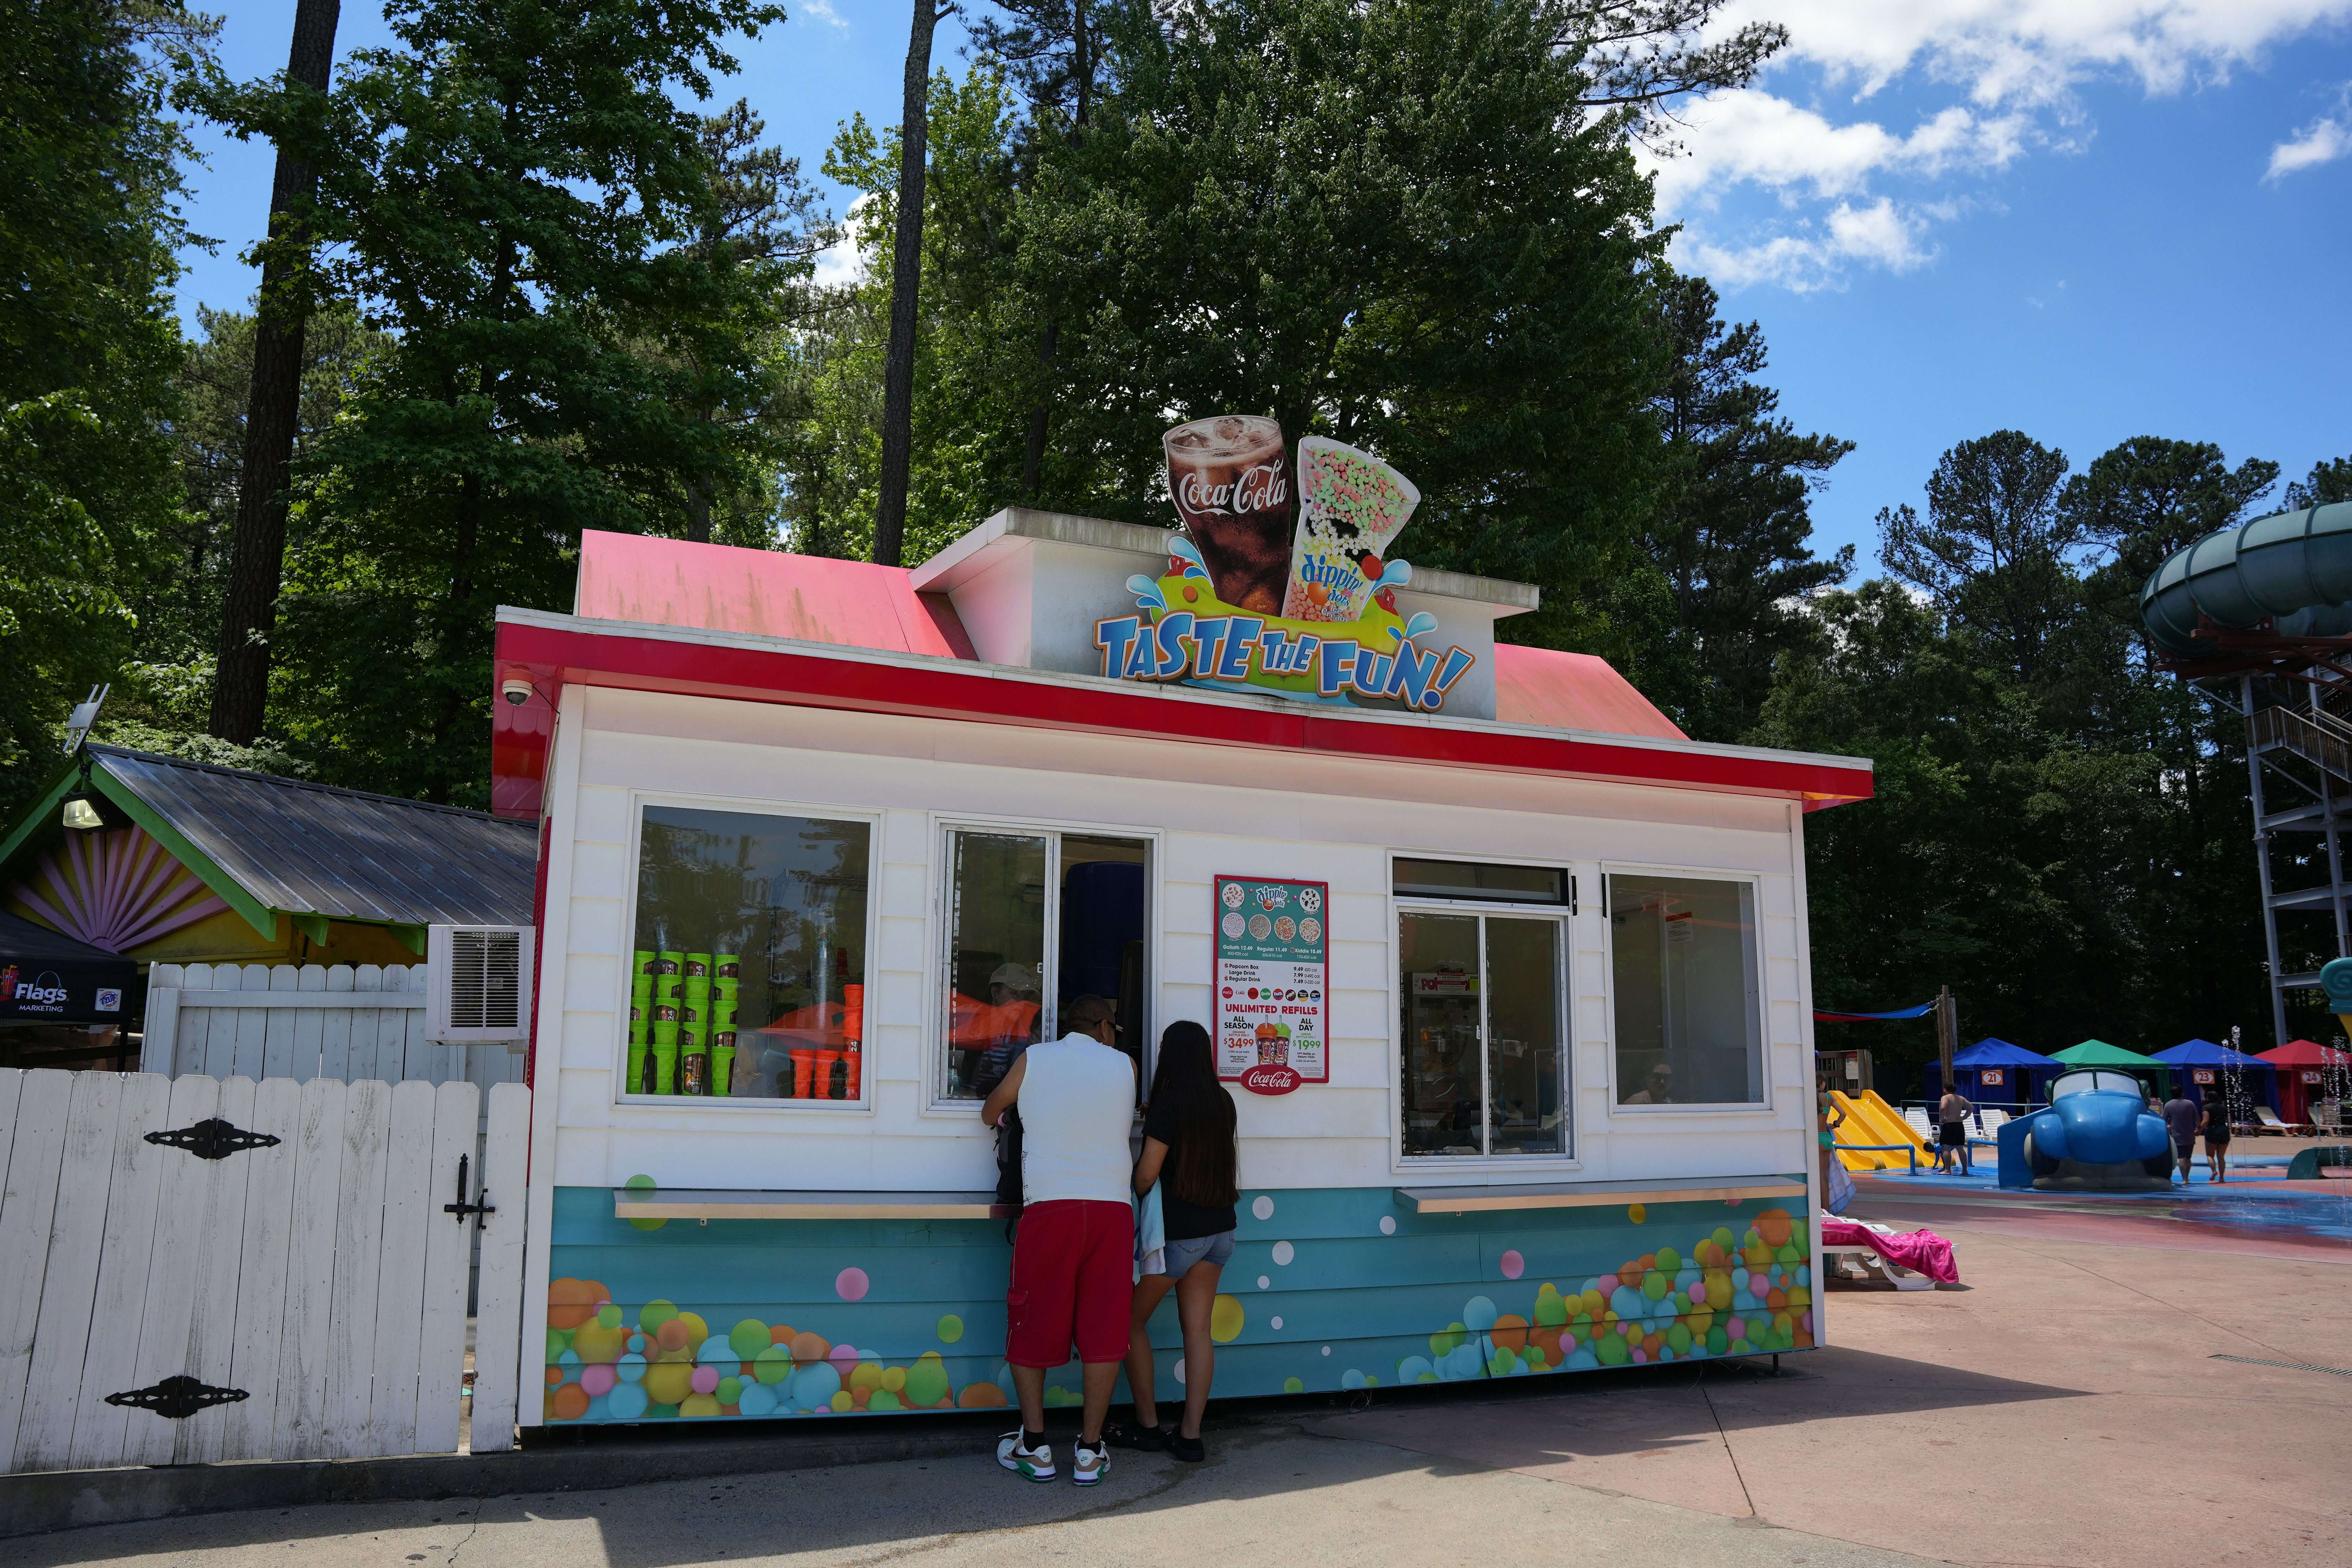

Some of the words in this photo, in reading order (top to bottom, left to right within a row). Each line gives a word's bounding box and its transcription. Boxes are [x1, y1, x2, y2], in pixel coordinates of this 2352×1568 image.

[1179, 456, 1287, 516] Coca-Cola
[1302, 553, 1363, 592] dippin'
[1326, 589, 1351, 607] dots
[1321, 608, 1348, 622] Cream
[1330, 604, 1343, 614] Ice
[1098, 612, 1265, 679] TASTE
[1261, 631, 1321, 671] THE
[1321, 639, 1474, 708] FUN!
[1256, 886, 1287, 902] dippin'
[15, 983, 68, 1004] Flags
[1225, 1004, 1277, 1014] UNLIMITED
[1282, 1006, 1318, 1015] REFILLS
[1249, 1071, 1293, 1087] Coca-Cola
[1988, 1073, 1996, 1082] 21
[2198, 1072, 2209, 1081] 23
[2306, 1073, 2317, 1081] 24
